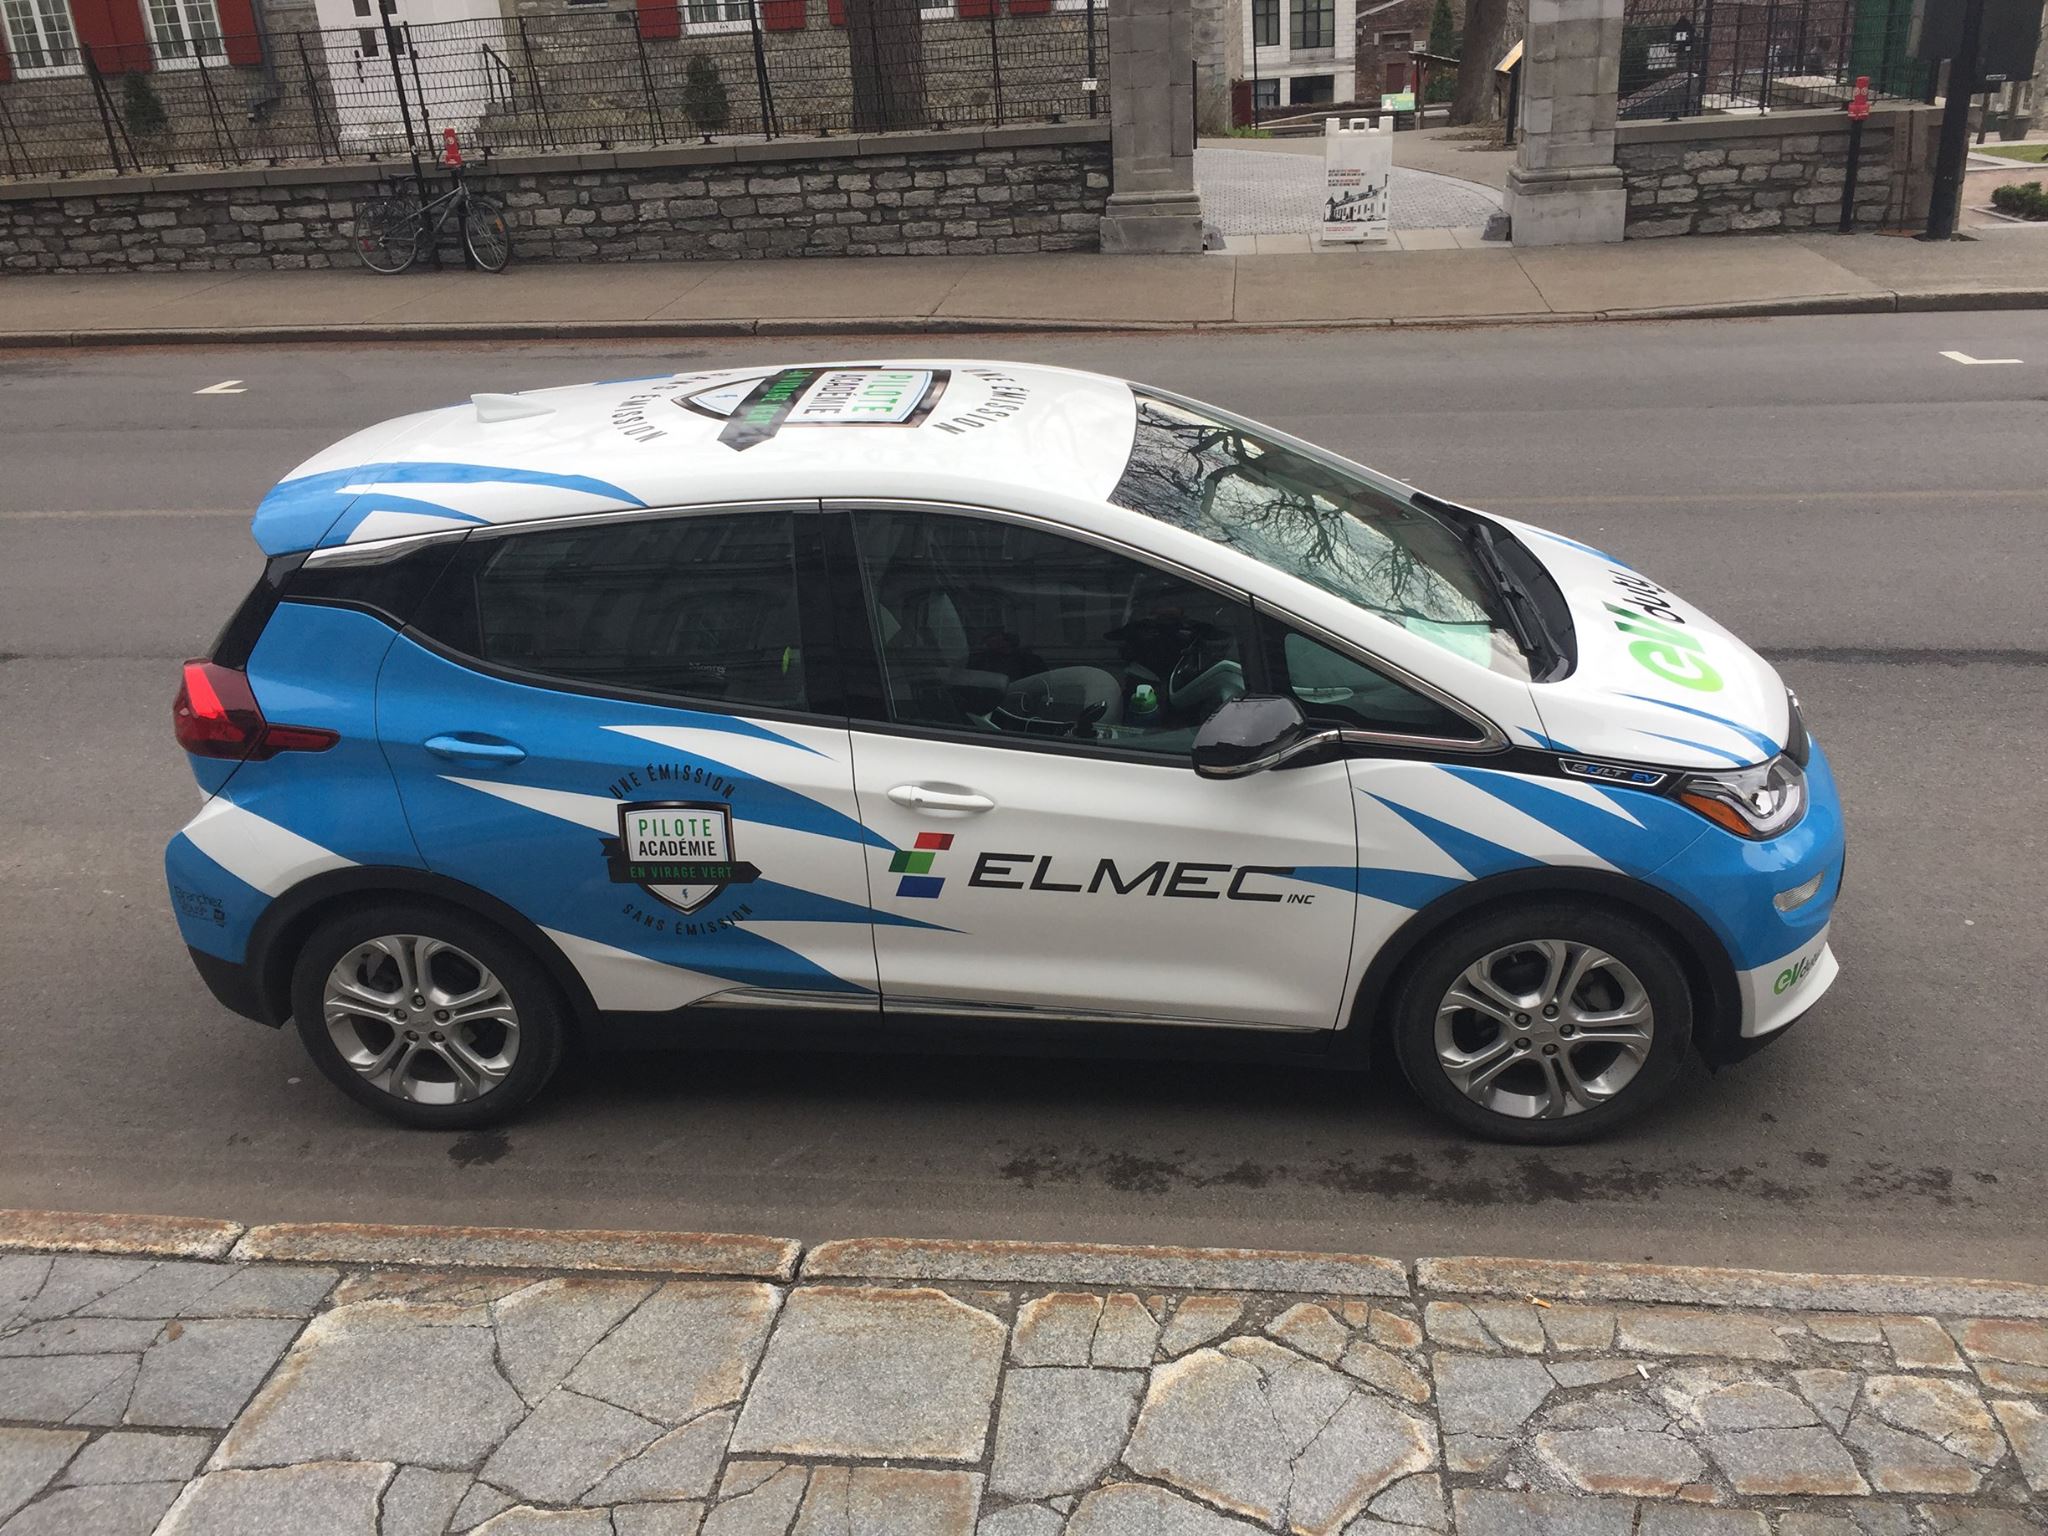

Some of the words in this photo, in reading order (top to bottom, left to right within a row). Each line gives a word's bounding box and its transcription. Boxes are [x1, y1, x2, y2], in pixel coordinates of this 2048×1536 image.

[803, 372, 864, 414] ACADÉMIE
[851, 373, 914, 413] PILOTE
[932, 385, 1031, 435] ÉMISSION
[609, 771, 642, 799] UNE
[646, 763, 736, 799] ÉMISSION
[1631, 773, 1658, 783] EV
[638, 818, 713, 837] PILOTE
[638, 838, 717, 856] ACADÉMIE
[630, 867, 646, 878] EN
[651, 866, 697, 878] VIRAGE
[701, 866, 733, 878] VERT
[967, 851, 1297, 903] ELMEC
[1287, 894, 1317, 906] INC
[622, 903, 665, 932] SANS
[675, 903, 753, 936] ÉMISSION
